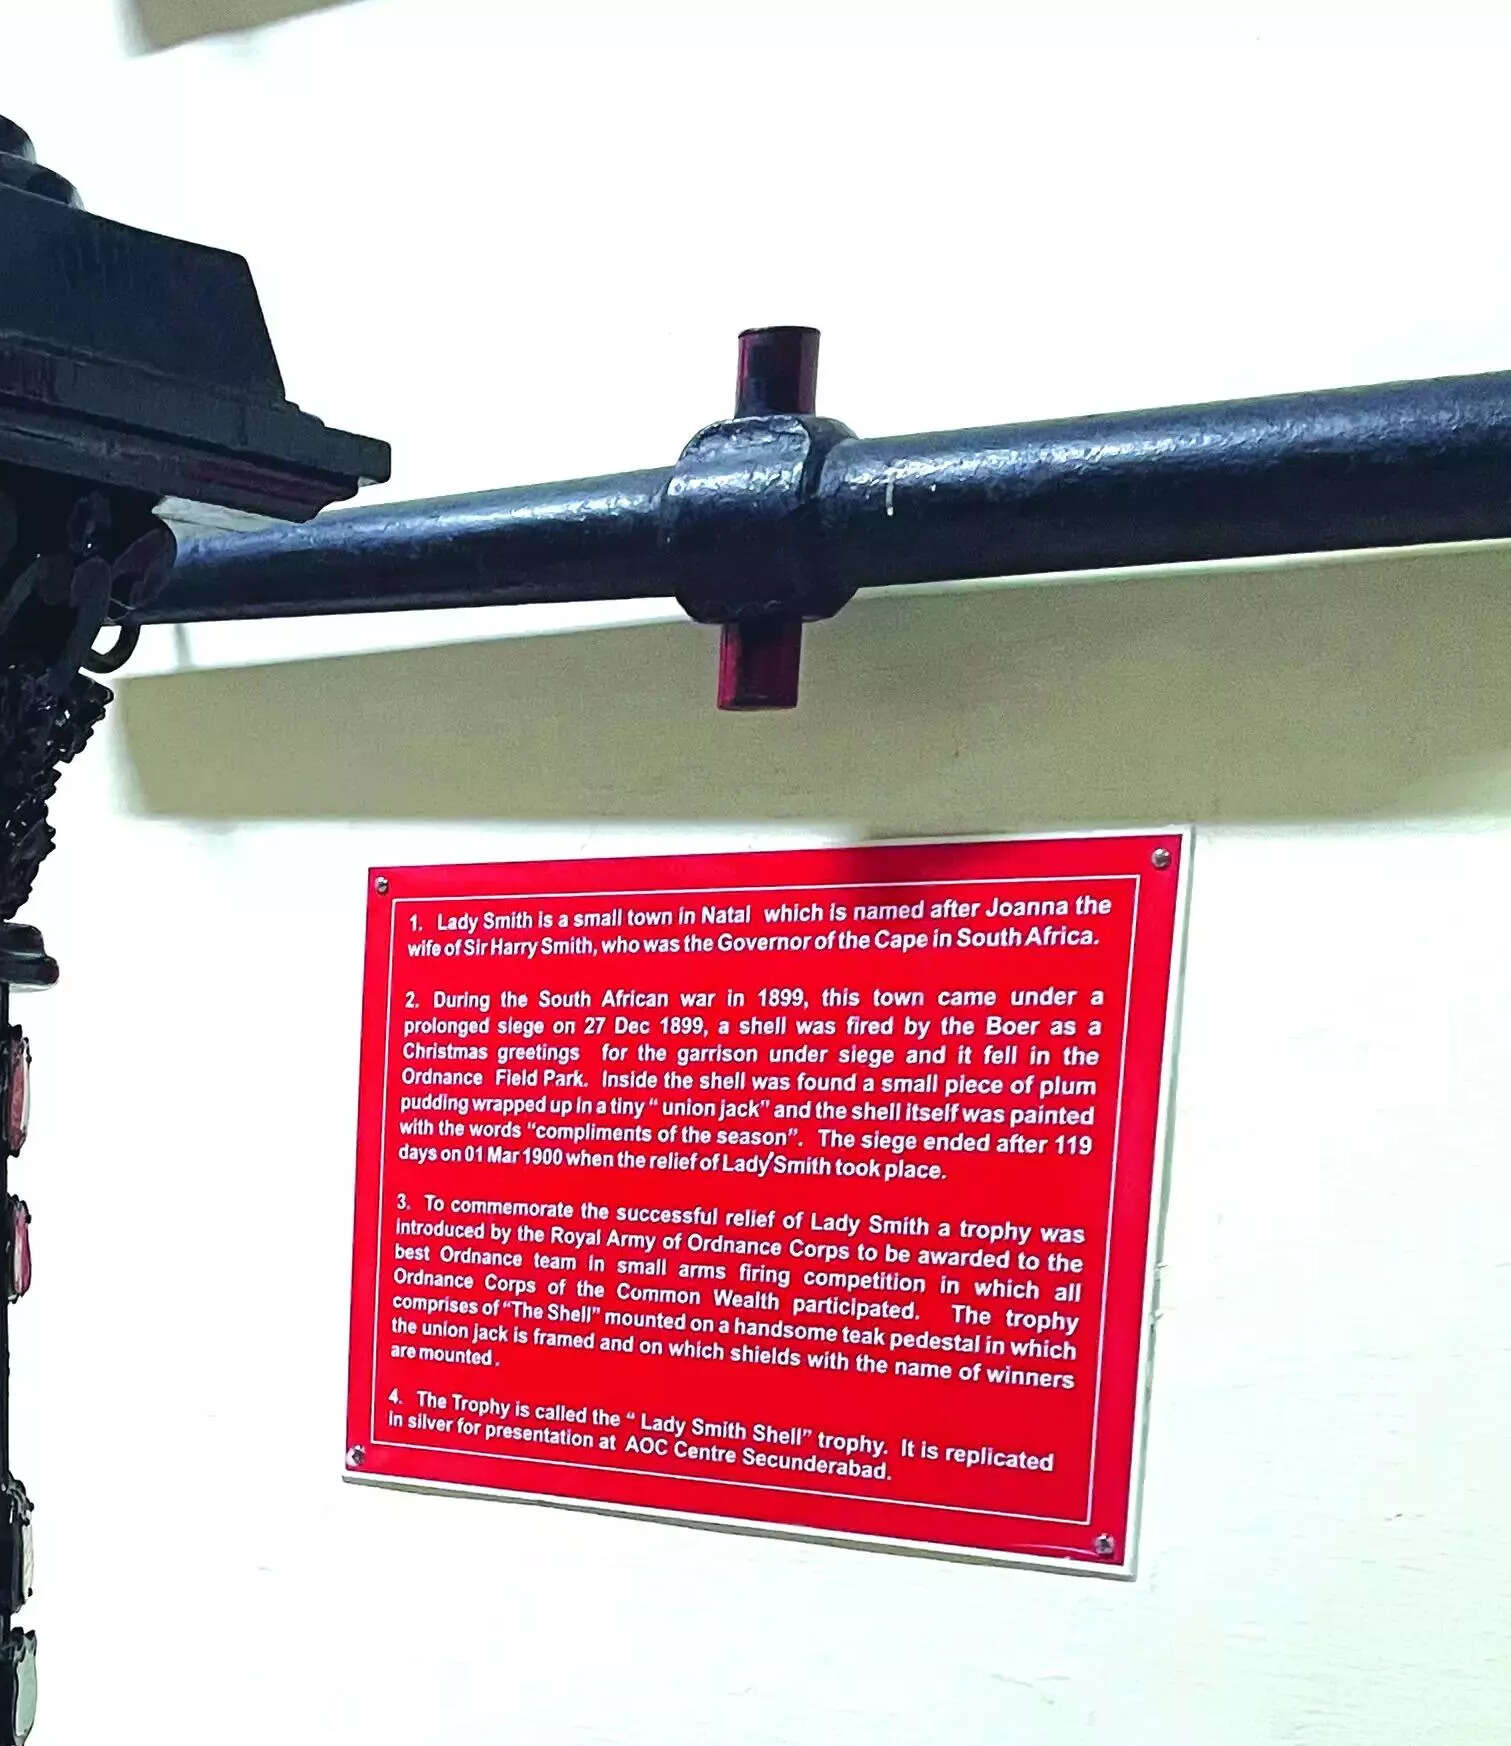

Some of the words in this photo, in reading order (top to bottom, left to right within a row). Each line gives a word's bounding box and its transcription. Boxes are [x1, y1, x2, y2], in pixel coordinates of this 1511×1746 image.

[409, 914, 423, 932] 1.
[437, 912, 479, 935] Lady
[482, 911, 533, 930] Smith
[538, 910, 554, 928] is
[557, 914, 569, 928] a
[573, 908, 623, 928] small
[627, 908, 673, 926] town
[678, 906, 696, 925] in
[701, 904, 751, 924] Natal
[764, 902, 824, 923] which
[829, 902, 848, 922] is
[853, 899, 925, 921] named
[930, 898, 981, 919] after
[985, 897, 1069, 918] Joanna
[1075, 895, 1112, 916] the
[404, 990, 420, 1009] 2.
[433, 990, 491, 1013] During
[500, 990, 528, 1008] the
[538, 989, 592, 1008] South
[601, 988, 669, 1008] African
[680, 992, 716, 1008] war
[727, 988, 745, 1007] in
[758, 987, 809, 1009] 1899,
[821, 987, 860, 1007] this
[873, 988, 924, 1007] town
[937, 991, 997, 1007] came
[1010, 986, 1078, 1006] under
[1090, 990, 1104, 1006] a
[403, 1016, 490, 1038] prolonged
[497, 1016, 545, 1039] siege
[552, 1020, 576, 1034] on
[583, 1016, 606, 1035] 27
[614, 1016, 650, 1035] Dec
[659, 1016, 709, 1038] 1899,
[718, 1020, 730, 1035] a
[739, 1016, 787, 1035] shell
[795, 1020, 836, 1035] was
[846, 1015, 894, 1036] fired
[903, 1015, 931, 1040] by
[940, 1015, 975, 1036] the
[985, 1015, 1041, 1036] Boer
[1049, 1020, 1076, 1036] as
[1087, 1020, 1102, 1036] a
[402, 1042, 489, 1060] Christmas
[497, 1043, 580, 1066] greetings
[601, 1042, 629, 1062] for
[637, 1043, 667, 1062] the
[677, 1043, 758, 1066] garrison
[769, 1044, 829, 1064] under
[838, 1044, 895, 1069] siege
[905, 1044, 947, 1064] and
[958, 1044, 972, 1065] it
[983, 1044, 1018, 1065] fell
[1029, 1045, 1050, 1065] in
[1063, 1046, 1100, 1066] the
[401, 1066, 484, 1086] Ordnance
[495, 1068, 538, 1087] Field
[543, 1068, 589, 1088] Park.
[602, 1069, 658, 1089] Inside
[663, 1070, 694, 1090] the
[699, 1071, 746, 1090] shell
[751, 1076, 791, 1091] was
[796, 1071, 857, 1092] found
[862, 1077, 875, 1092] a
[881, 1073, 938, 1093] small
[944, 1074, 1004, 1098] piece
[1009, 1074, 1035, 1095] of
[1039, 1075, 1097, 1100] plum
[817, 1128, 856, 1148] The
[860, 1130, 918, 1154] siege
[923, 1132, 991, 1152] ended
[996, 1133, 1049, 1154] after
[1054, 1134, 1093, 1156] 119
[424, 1194, 445, 1212] To
[450, 1199, 574, 1218] commemorate
[580, 1202, 610, 1220] the
[616, 1206, 718, 1226] successful
[725, 1208, 776, 1228] relief
[782, 1211, 805, 1230] of
[810, 1212, 861, 1237] Lady
[868, 1214, 930, 1236] Smith
[937, 1222, 951, 1237] a
[959, 1220, 1032, 1246] trophy
[1040, 1227, 1086, 1244] was
[396, 1217, 485, 1240] introduced
[490, 1223, 512, 1245] by
[517, 1224, 545, 1243] the
[550, 1226, 602, 1250] Royal
[606, 1228, 656, 1254] Army
[662, 1232, 683, 1250] of
[687, 1232, 782, 1256] Ordnance
[789, 1238, 850, 1263] Corps
[857, 1243, 878, 1262] to
[885, 1243, 911, 1263] be
[917, 1248, 1010, 1269] awarded
[1017, 1251, 1040, 1271] to
[1047, 1252, 1084, 1274] the
[394, 1242, 430, 1262] best
[439, 1244, 523, 1267] Ordnance
[533, 1252, 577, 1271] team
[588, 1254, 605, 1272] in
[616, 1258, 667, 1276] small
[678, 1263, 726, 1280] arms
[739, 1262, 791, 1288] firing
[803, 1271, 926, 1293] competition
[940, 1275, 960, 1295] in
[974, 1278, 1040, 1300] which
[1054, 1282, 1082, 1303] all
[393, 1266, 474, 1290] Ordnance
[484, 1272, 537, 1297] Corps
[547, 1278, 567, 1296] of
[576, 1279, 605, 1298] the
[616, 1282, 701, 1305] Common
[713, 1288, 780, 1311] Wealth
[792, 1296, 920, 1321] participated.
[951, 1304, 992, 1326] The
[1005, 1309, 1080, 1336] trophy
[391, 1316, 418, 1335] the
[422, 1320, 469, 1339] union
[471, 1322, 508, 1344] jack
[513, 1326, 528, 1344] is
[533, 1327, 595, 1349] framed
[599, 1335, 634, 1353] and
[639, 1340, 663, 1355] on
[668, 1339, 725, 1361] which
[730, 1344, 801, 1366] shields
[807, 1350, 849, 1371] with
[855, 1354, 888, 1374] the
[894, 1361, 952, 1379] name
[958, 1362, 982, 1382] of
[986, 1365, 1075, 1390] winners
[388, 1410, 403, 1427] in
[407, 1412, 454, 1433] silver
[456, 1416, 482, 1436] for
[485, 1424, 594, 1448] presentation
[598, 1434, 617, 1451] at
[624, 1435, 668, 1456] AOC
[673, 1440, 737, 1464] Centre
[742, 1447, 892, 1481] Secunderabad.
